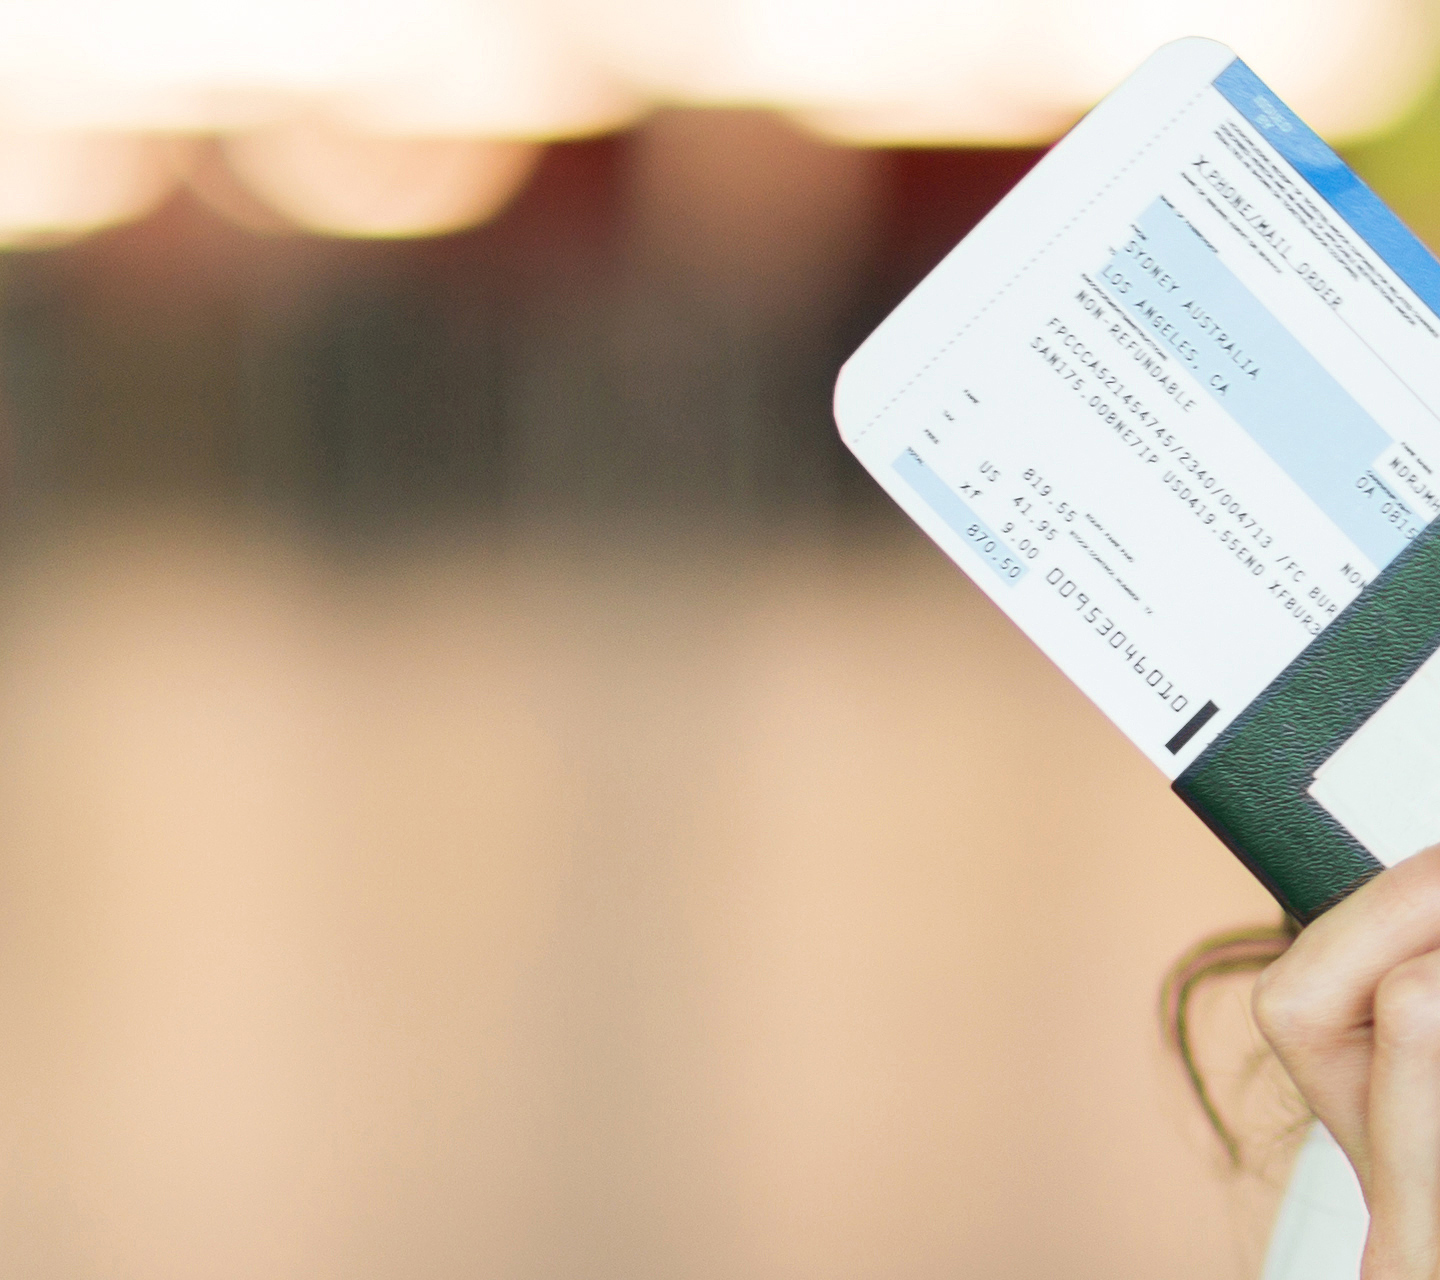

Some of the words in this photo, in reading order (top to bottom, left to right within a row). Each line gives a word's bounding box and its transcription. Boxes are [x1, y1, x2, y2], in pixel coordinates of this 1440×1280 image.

[1122, 239, 1180, 293] SYDNEY
[1179, 300, 1260, 380] AUSTRALIA
[1293, 262, 1342, 311] ORDER
[1073, 289, 1196, 412] NON-REFUNDABLE
[1100, 263, 1133, 294] LOS
[1131, 299, 1198, 369] ANGELES,
[1209, 374, 1230, 396] CA
[978, 460, 1001, 482] US
[1011, 496, 1058, 540] 41.95
[1022, 467, 1078, 522] 819.55
[964, 520, 1025, 583] 870.50
[1000, 521, 1039, 559] 9.00
